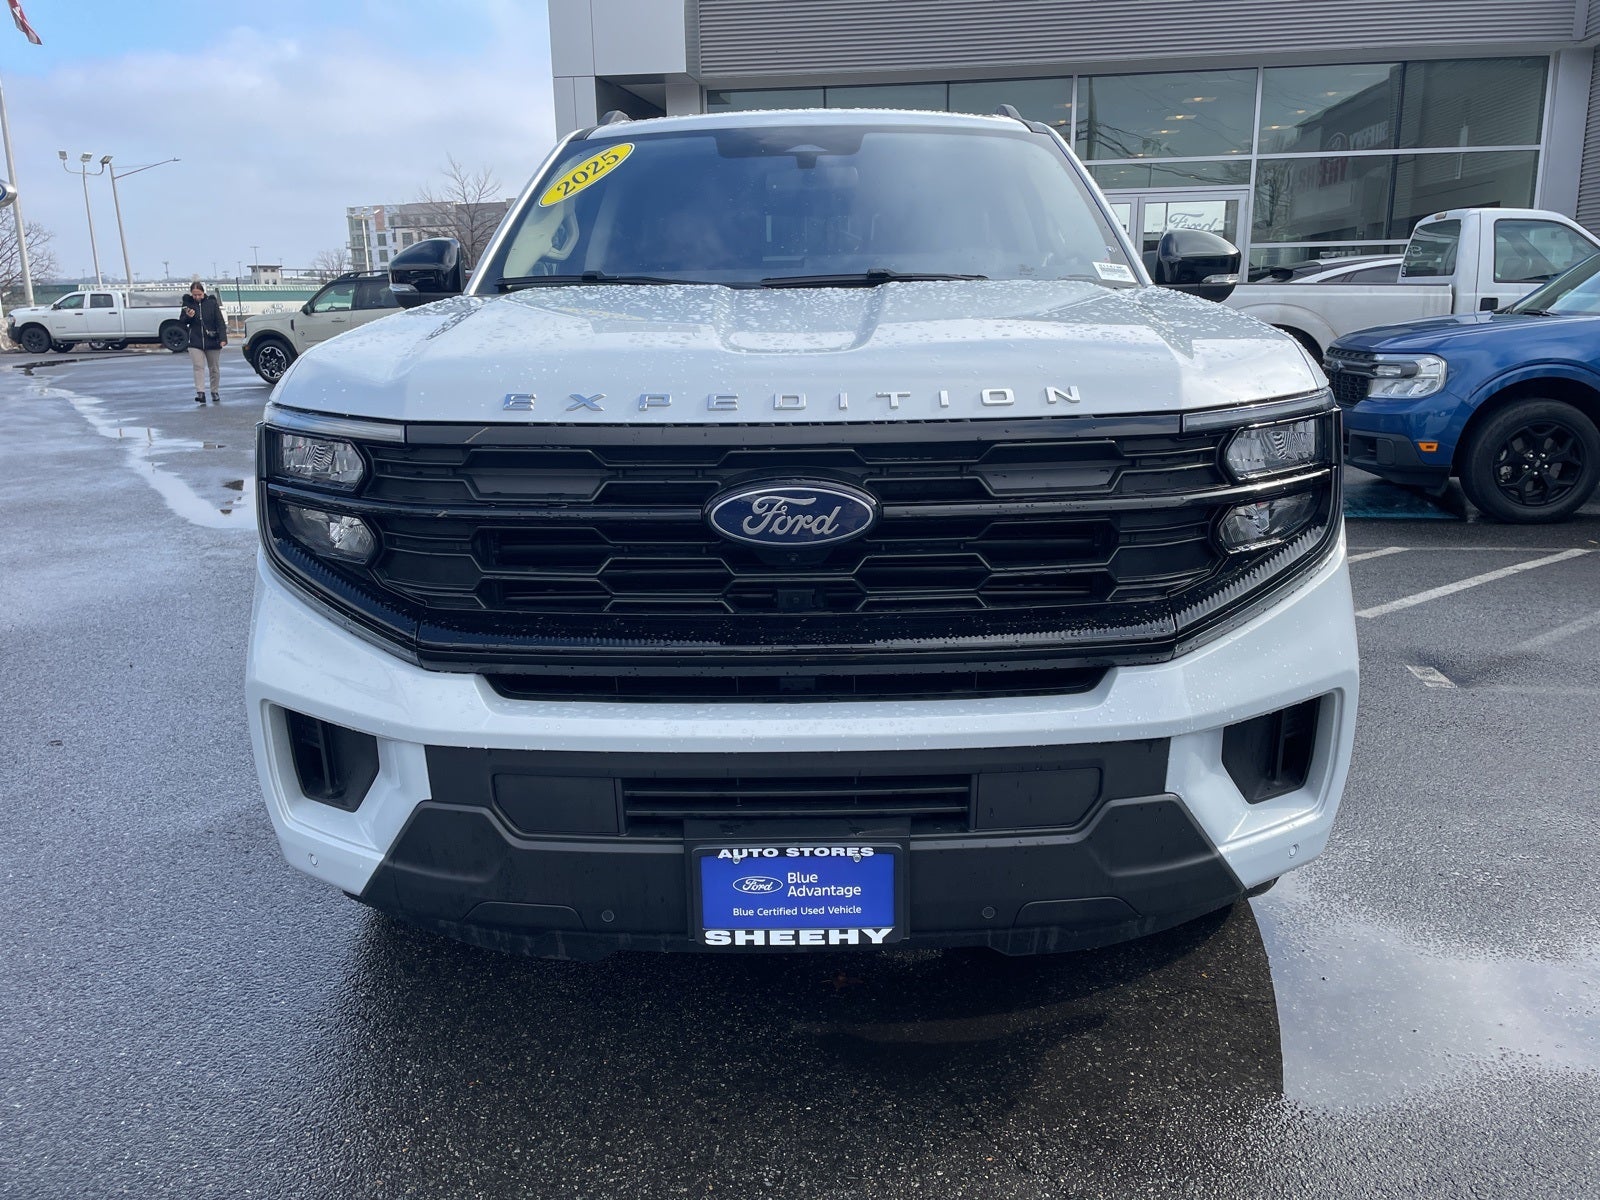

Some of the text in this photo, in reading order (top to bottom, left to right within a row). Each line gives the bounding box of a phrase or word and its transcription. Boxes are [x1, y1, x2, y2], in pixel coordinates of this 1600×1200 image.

[557, 151, 619, 196] 2025
[503, 386, 1081, 412] EXPEDITION
[742, 495, 840, 537] Ford
[718, 847, 875, 859] AUTO STORES
[787, 872, 818, 884] Blue
[742, 879, 773, 892] Ford
[787, 885, 862, 898] Advantage
[733, 905, 862, 916] Blue Certified Used Vehicle
[704, 928, 893, 946] SHEEHY
